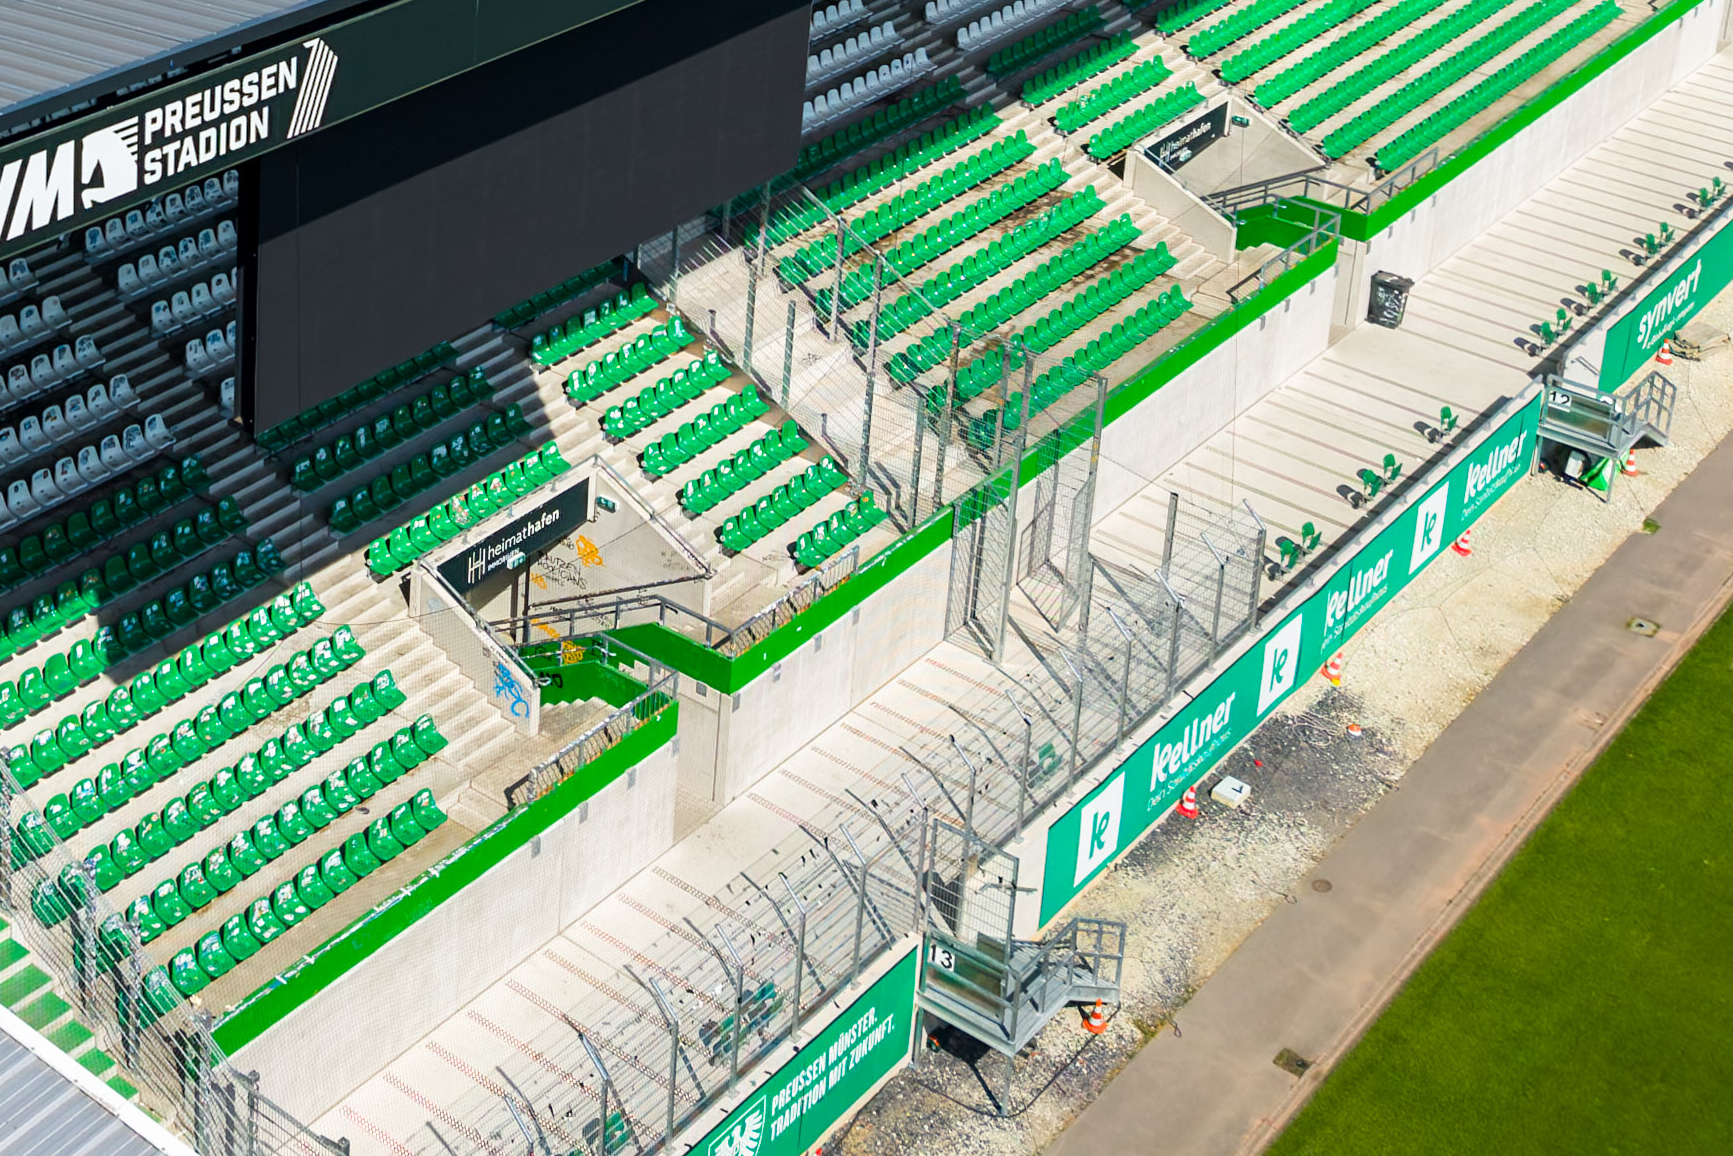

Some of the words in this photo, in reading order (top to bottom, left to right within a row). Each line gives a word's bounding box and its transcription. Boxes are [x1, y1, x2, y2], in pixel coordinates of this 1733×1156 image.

[144, 57, 297, 145] PREUSSEN
[143, 105, 270, 185] STADION
[1637, 259, 1702, 350] synvert
[1550, 391, 1570, 404] 12
[488, 509, 560, 560] heimathafen
[931, 945, 952, 968] 13
[771, 1052, 826, 1116] PREUSSEN
[828, 1007, 878, 1066] MÜNSTER.
[771, 1077, 827, 1141] TRADITION
[828, 1056, 848, 1089] MIT
[848, 1013, 894, 1070] ZUKUNFT.
